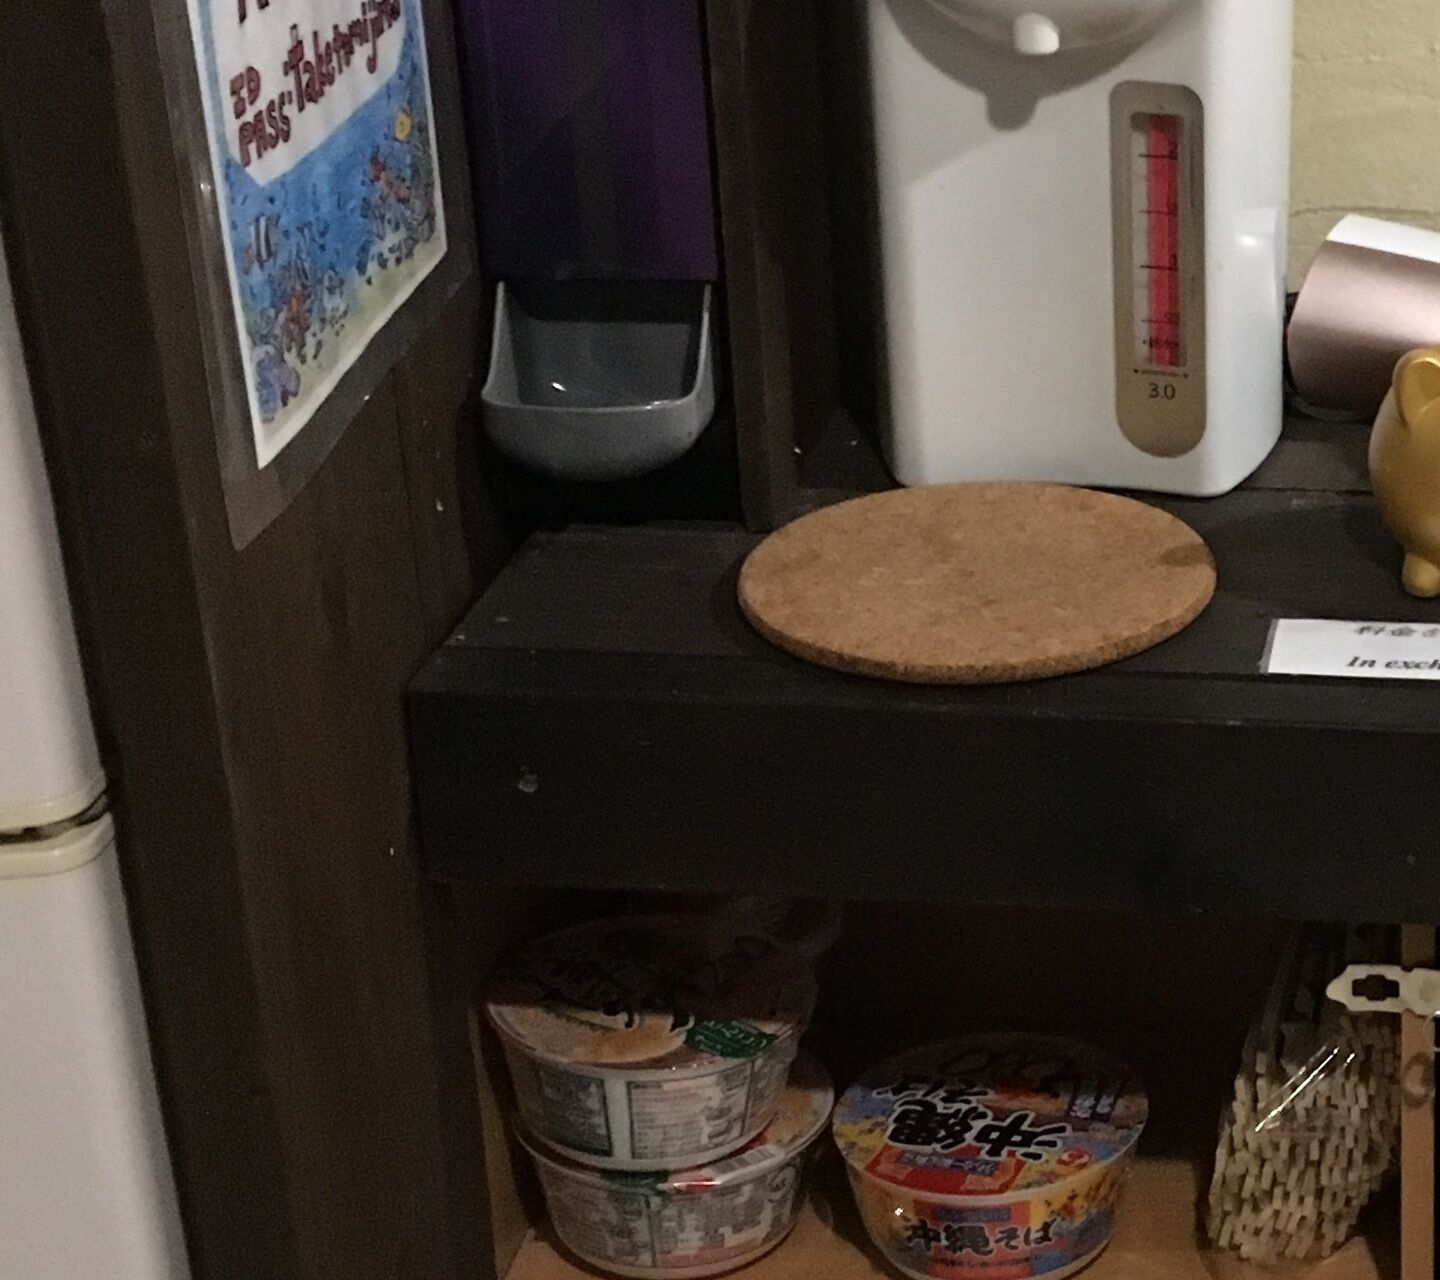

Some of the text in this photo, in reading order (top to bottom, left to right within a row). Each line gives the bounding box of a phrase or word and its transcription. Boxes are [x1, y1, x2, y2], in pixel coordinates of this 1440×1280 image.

[238, 91, 292, 168] PASS
[1148, 382, 1176, 400] 3.0
[1346, 655, 1376, 669] In
